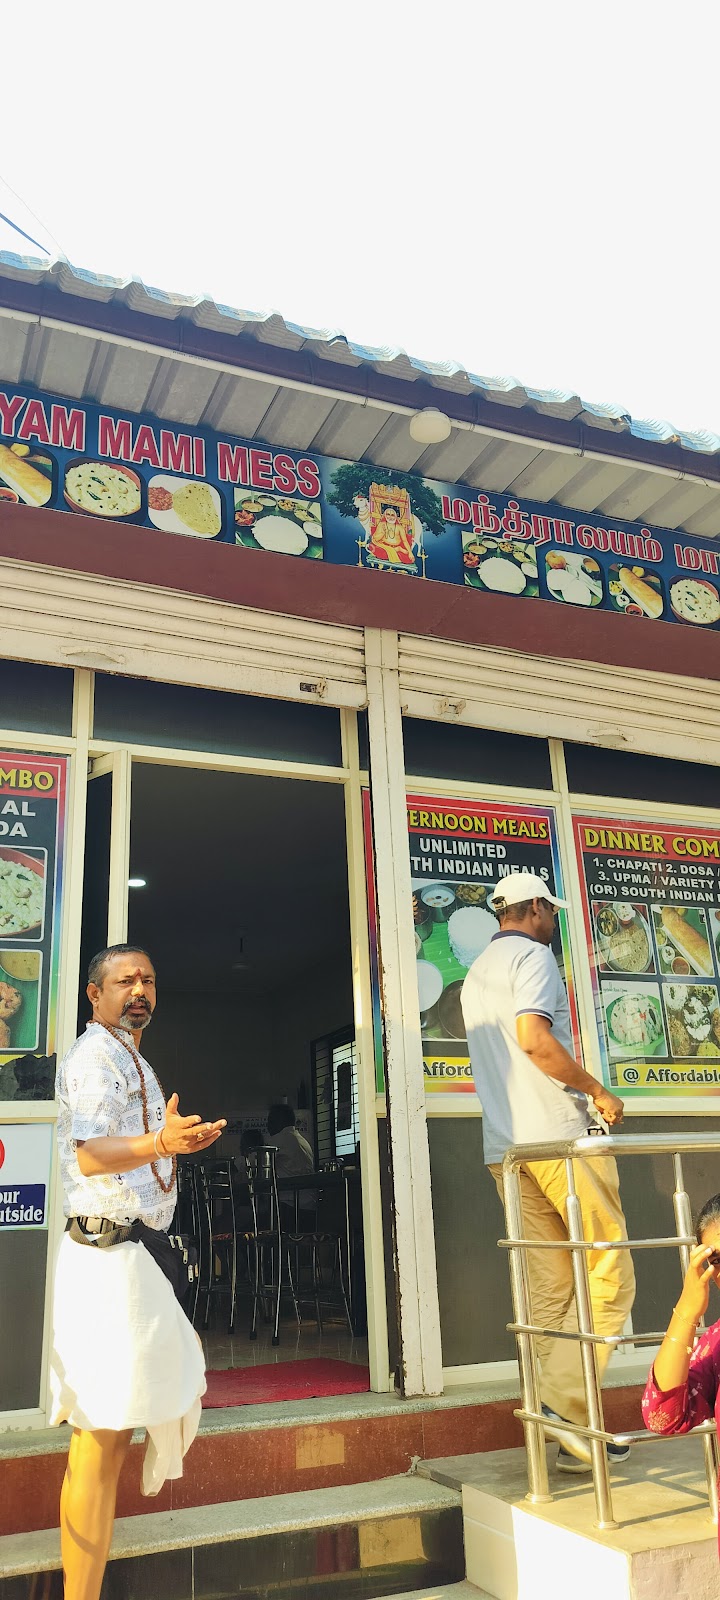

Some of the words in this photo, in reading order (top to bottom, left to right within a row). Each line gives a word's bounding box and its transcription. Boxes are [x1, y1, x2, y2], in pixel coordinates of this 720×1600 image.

[0, 392, 86, 452] YAM
[98, 414, 206, 477] MAMI
[217, 442, 321, 498] MESS
[441, 494, 664, 562] மந்த்ராலயம்
[0, 767, 54, 791] MBO
[1, 800, 36, 816] AL
[408, 809, 487, 833] ERNOON
[492, 817, 548, 838] MEALS
[420, 838, 506, 858] UNLIMITED
[584, 828, 667, 853] DINNER
[672, 837, 720, 858] COM
[411, 856, 432, 872] TH
[438, 858, 493, 877] INDIAN
[593, 857, 604, 867] 1.
[607, 859, 662, 872] CHAPATI
[666, 863, 677, 873] 2.
[680, 865, 714, 876] DOSA
[598, 871, 610, 881] 3.
[613, 872, 651, 884] UPMA
[661, 877, 714, 889] VARIETY
[590, 884, 617, 897] (OR)
[621, 886, 666, 899] SOUTH
[670, 890, 714, 902] INDIAN
[646, 1068, 720, 1082] Affordabl
